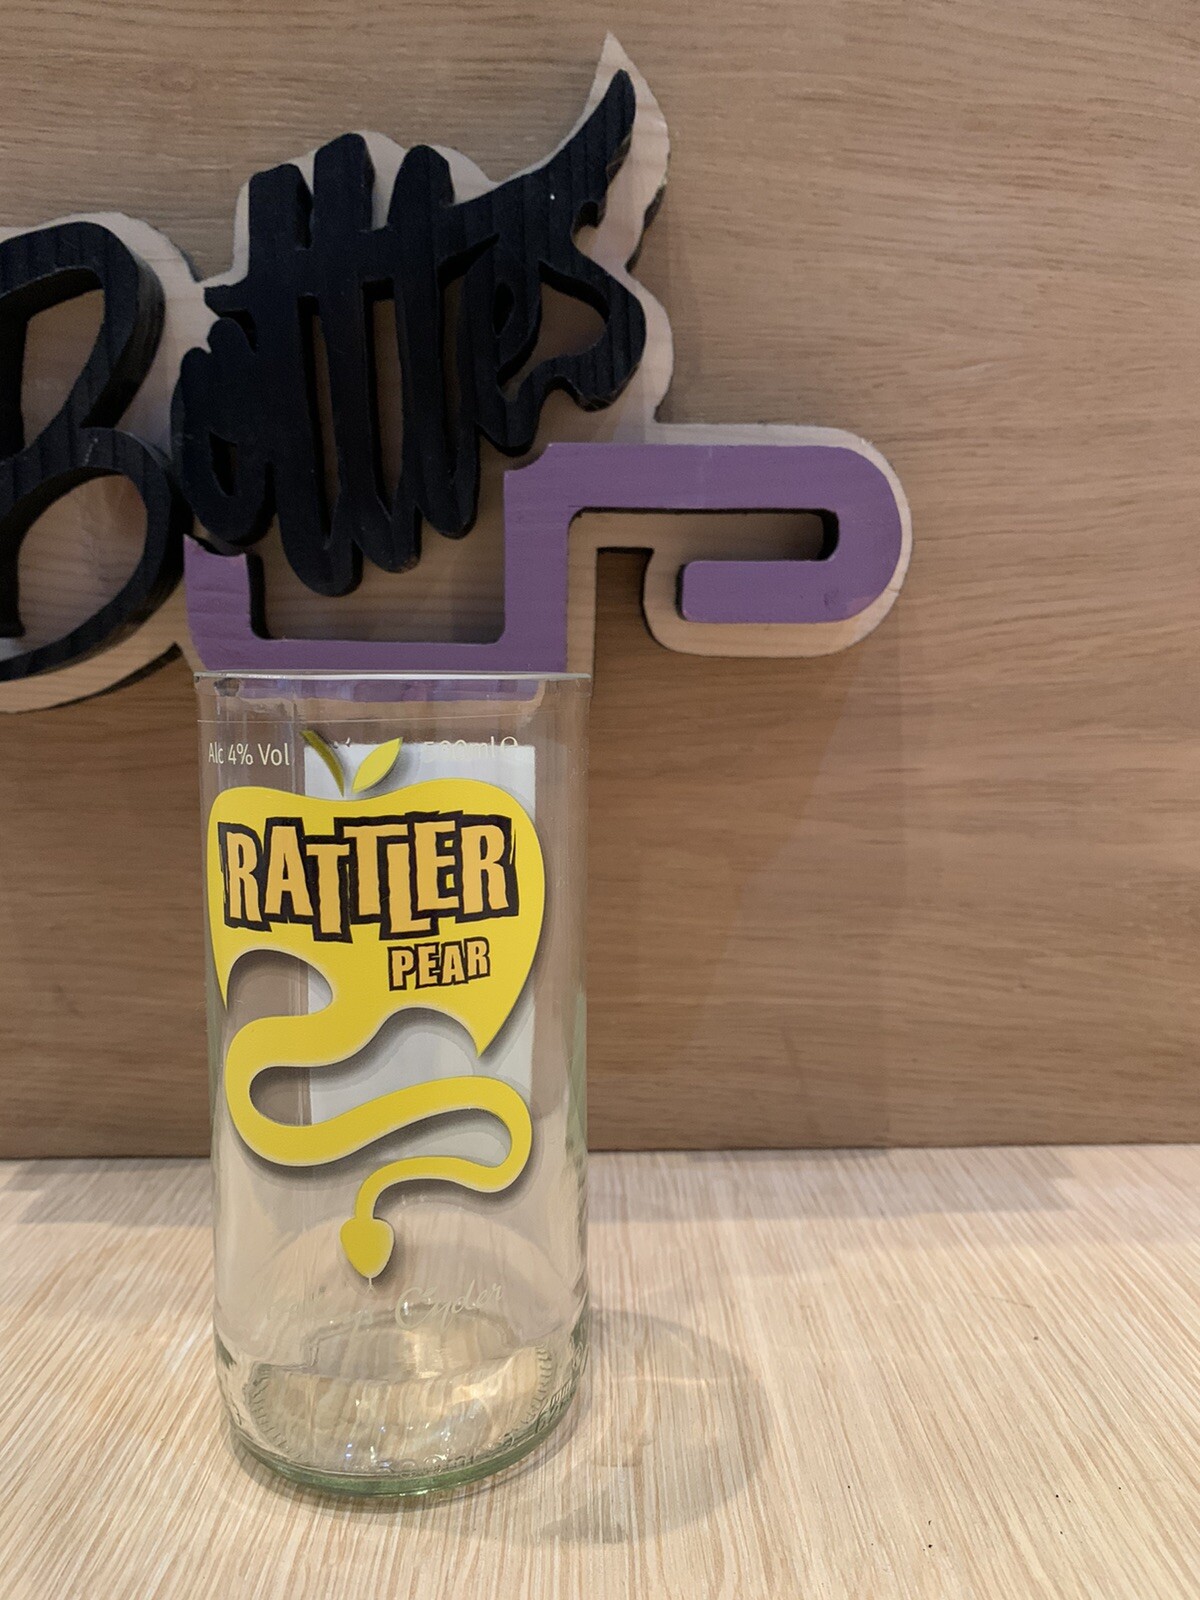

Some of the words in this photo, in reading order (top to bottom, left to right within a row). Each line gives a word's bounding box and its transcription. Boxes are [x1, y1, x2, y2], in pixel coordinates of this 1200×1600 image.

[208, 741, 224, 765] Alc
[227, 743, 254, 766] 4%
[257, 742, 290, 766] Vol
[217, 810, 520, 943] RATTLER
[387, 936, 491, 991] PEAR
